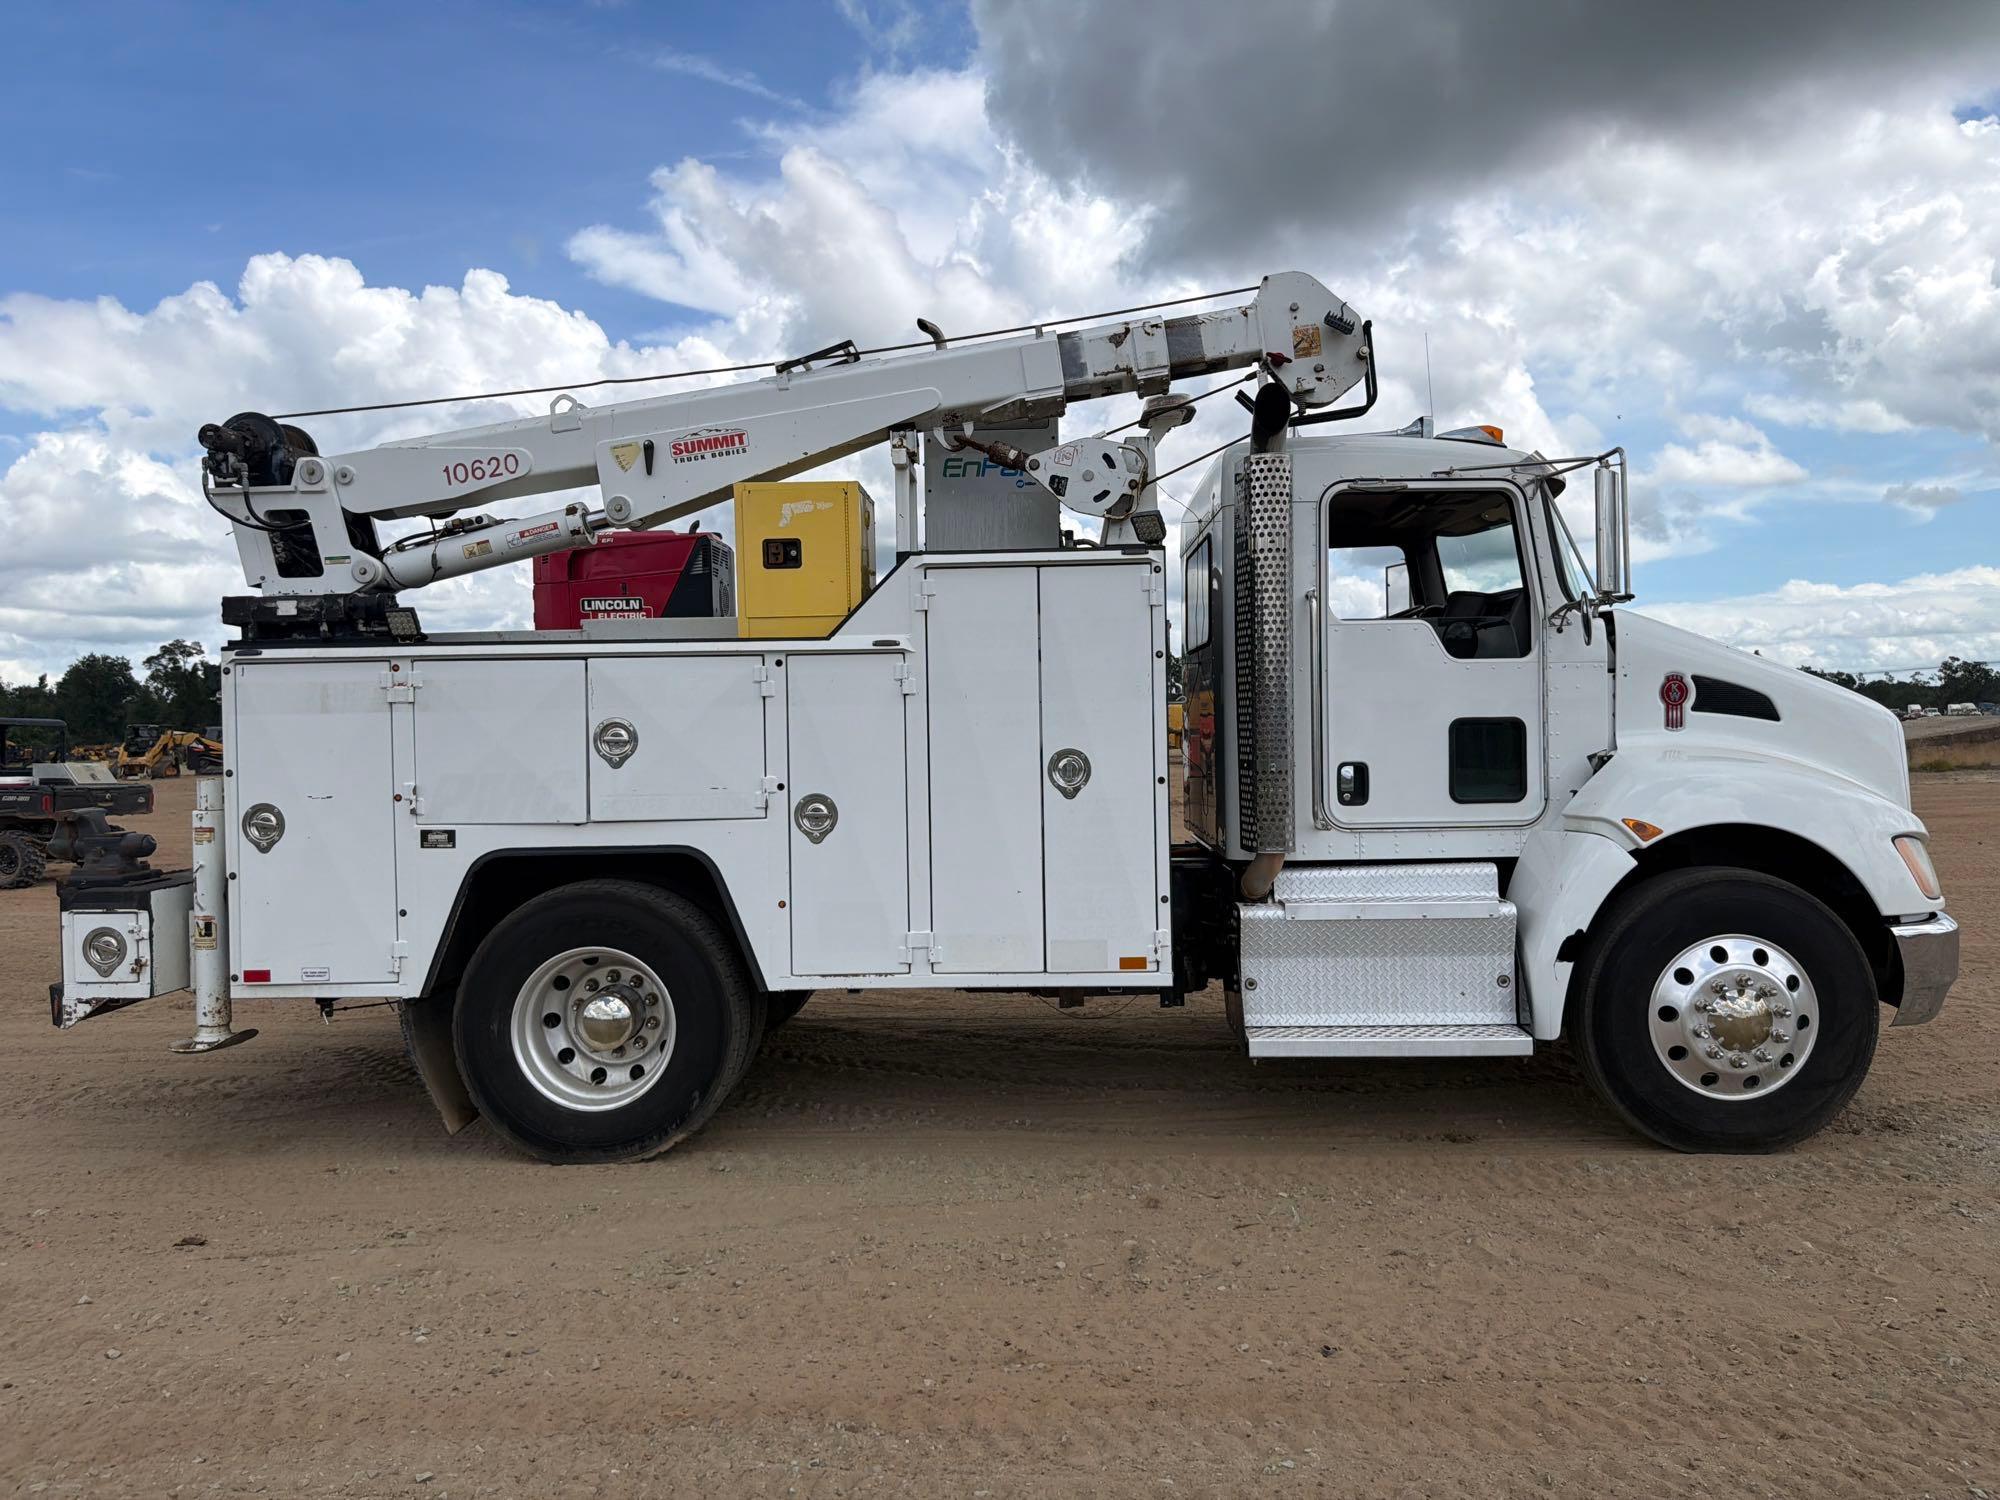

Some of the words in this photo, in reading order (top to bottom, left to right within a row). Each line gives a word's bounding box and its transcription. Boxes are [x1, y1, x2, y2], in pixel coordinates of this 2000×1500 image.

[671, 432, 746, 456] SUMMIT
[673, 454, 706, 465] TRUCK
[711, 447, 747, 459] BODIES
[442, 453, 519, 487] 10620
[529, 523, 555, 536] DANGER
[583, 599, 640, 611] LINCOLN
[597, 612, 647, 620] ELECTRIC
